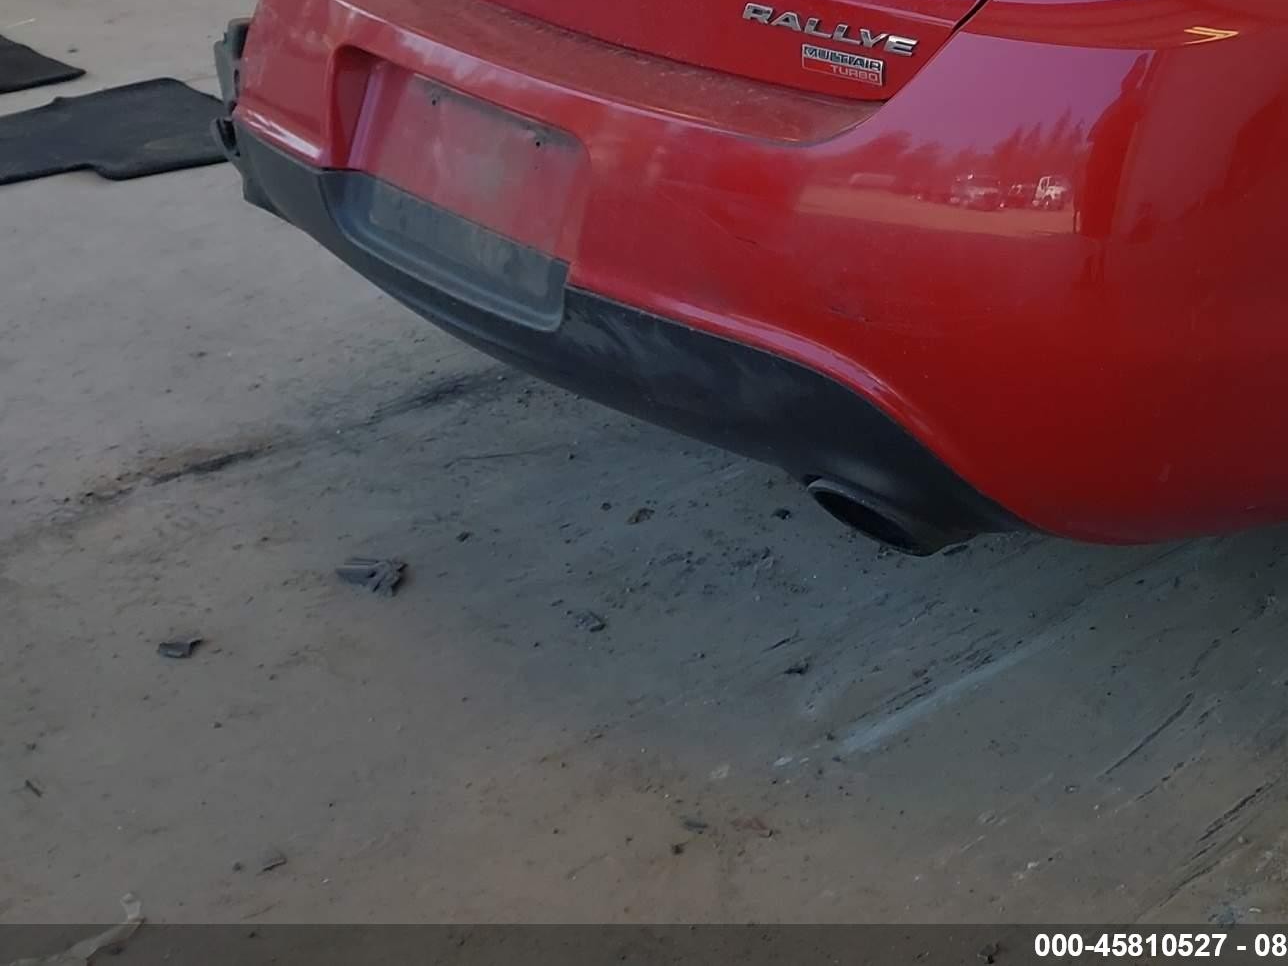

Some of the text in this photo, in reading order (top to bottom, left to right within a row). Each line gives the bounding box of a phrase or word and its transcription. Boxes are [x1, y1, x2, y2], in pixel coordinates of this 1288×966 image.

[742, 2, 920, 57] RALLYE
[803, 45, 882, 71] MULTIAIR
[830, 64, 879, 82] TURBO
